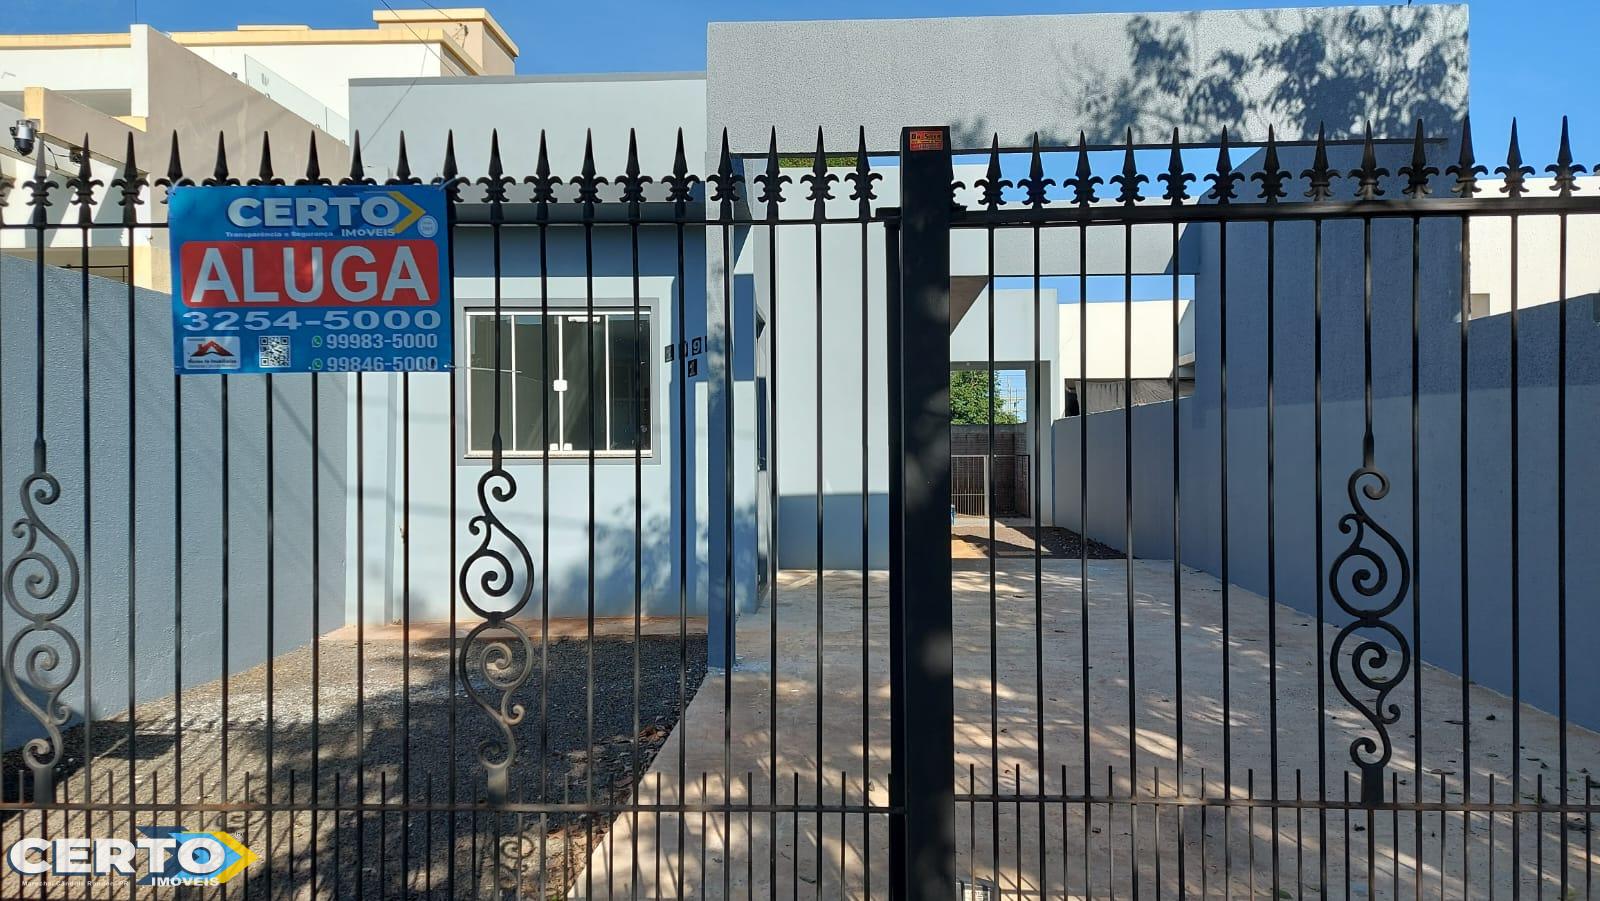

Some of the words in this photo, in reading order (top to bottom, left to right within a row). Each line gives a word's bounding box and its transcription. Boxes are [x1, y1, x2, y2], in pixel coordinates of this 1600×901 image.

[227, 197, 400, 228] CERTO
[190, 246, 431, 303] ALUGA
[182, 310, 441, 331] 3254-5000
[326, 333, 438, 349] 99983-5000
[327, 356, 438, 371] 99846-5000
